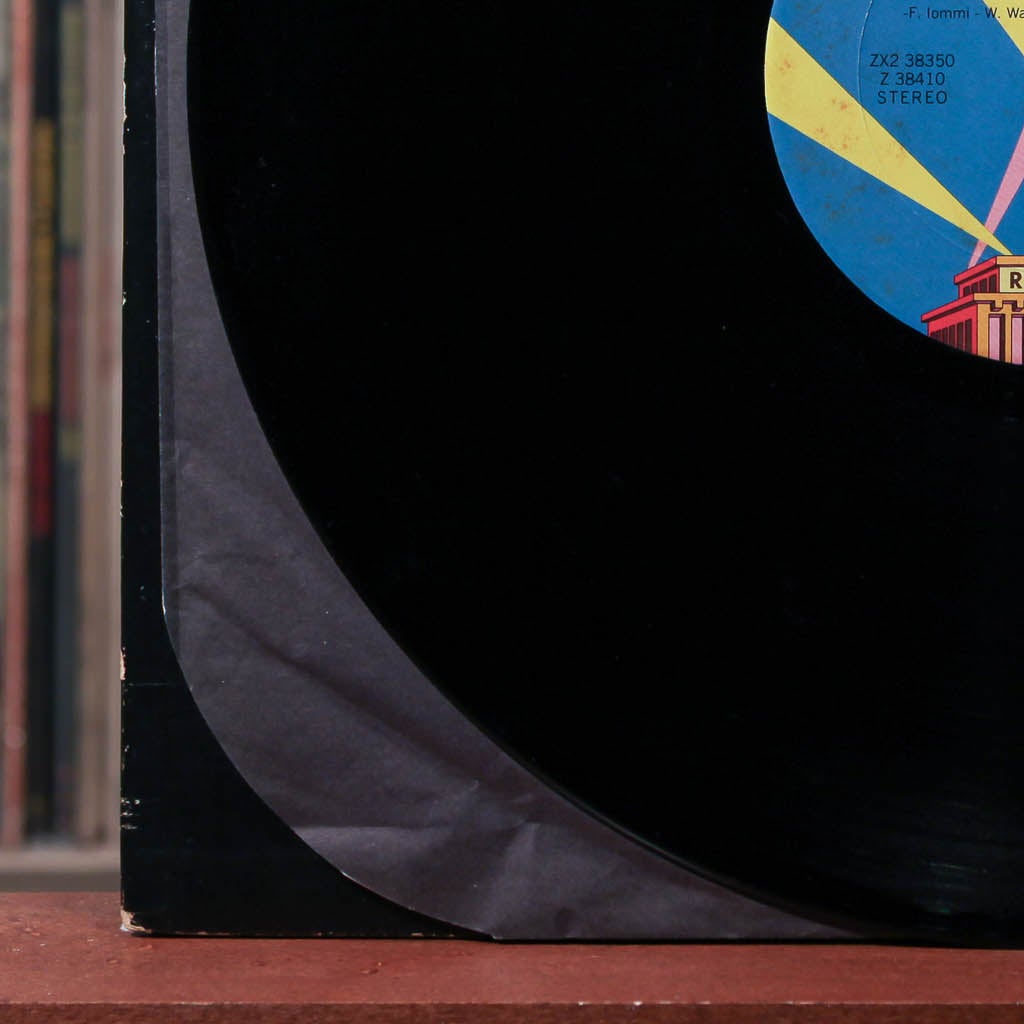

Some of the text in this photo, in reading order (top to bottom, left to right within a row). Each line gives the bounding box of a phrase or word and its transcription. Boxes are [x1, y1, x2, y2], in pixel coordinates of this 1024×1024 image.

[928, 7, 969, 19] Iommi
[985, 7, 1000, 19] W.
[869, 54, 955, 67] ZX2 38350
[880, 72, 945, 85] Z 38410
[877, 91, 948, 104] STEREO
